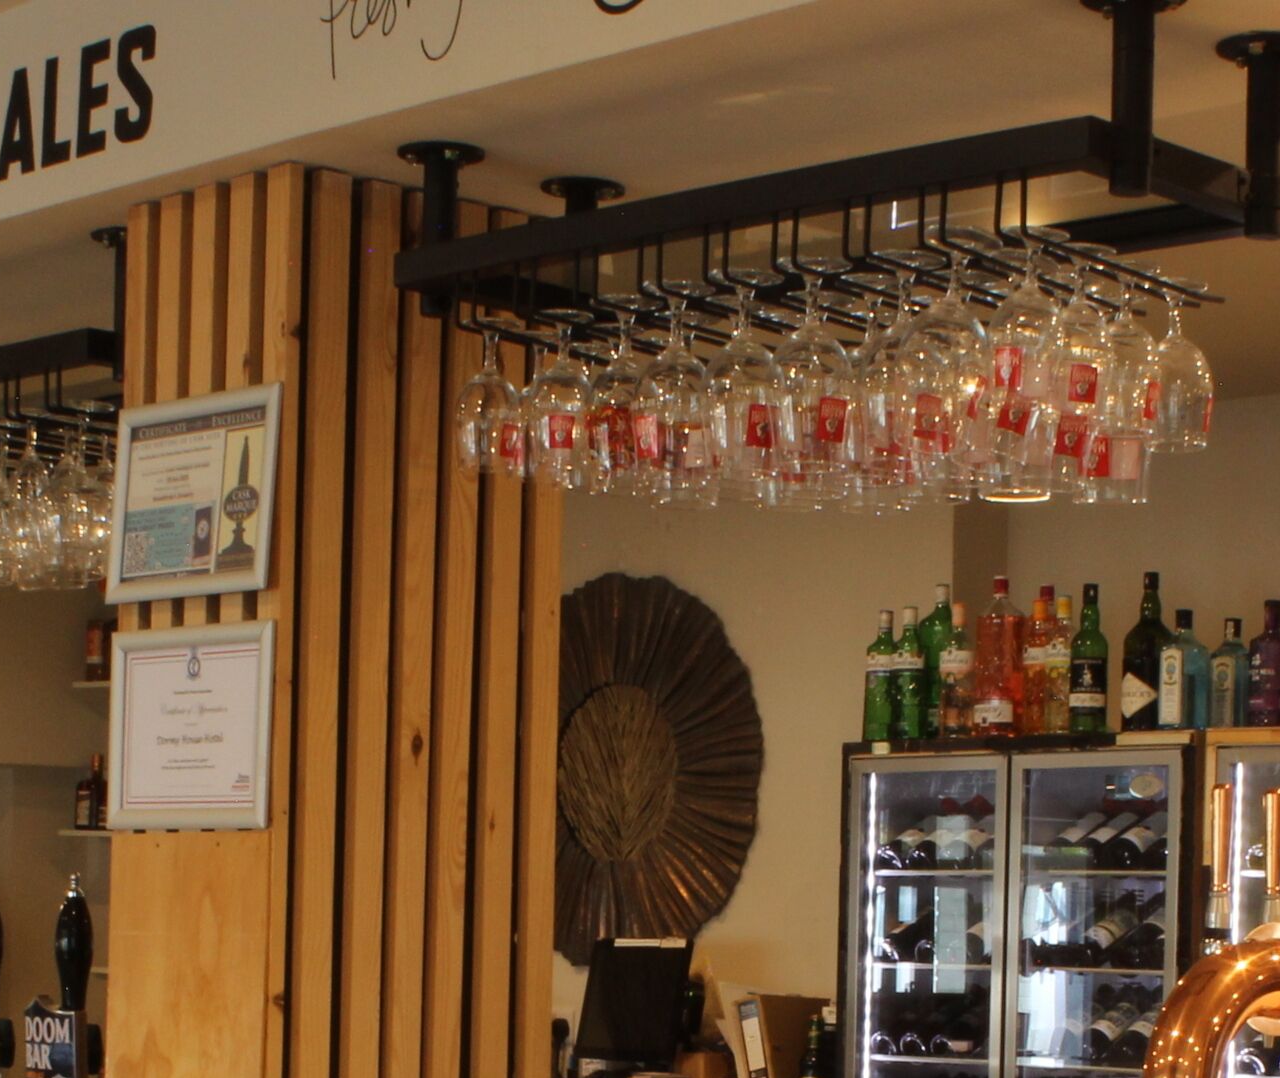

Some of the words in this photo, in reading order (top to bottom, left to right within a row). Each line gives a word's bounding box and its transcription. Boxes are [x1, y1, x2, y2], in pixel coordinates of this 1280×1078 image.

[138, 421, 188, 441] CERTIFICATE
[211, 409, 263, 428] EXCELLENCE
[225, 498, 258, 513] MARQUE
[231, 488, 252, 501] CASK
[24, 1015, 70, 1044] DOOM
[25, 1042, 53, 1071] BAR
